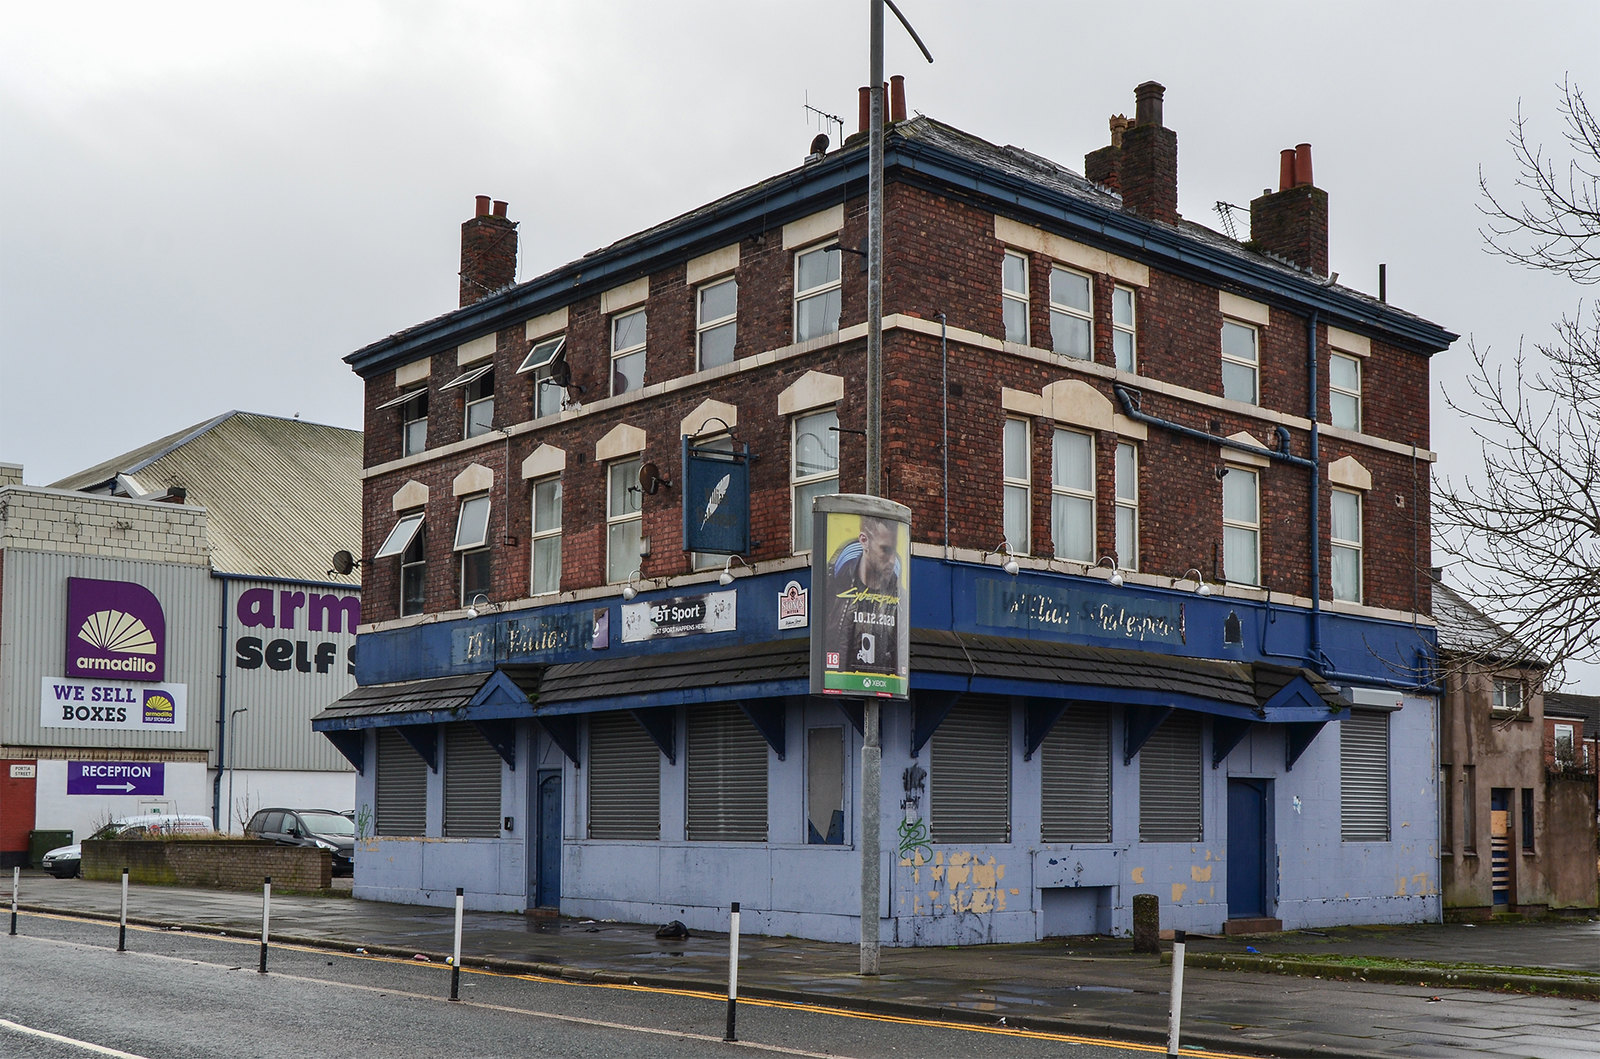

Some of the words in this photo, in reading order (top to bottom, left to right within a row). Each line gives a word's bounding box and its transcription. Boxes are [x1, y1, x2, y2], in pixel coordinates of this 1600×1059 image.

[671, 604, 700, 622] Sport
[853, 611, 895, 626] 10.12.2020
[236, 636, 336, 673] self
[827, 653, 839, 664] 18
[76, 656, 156, 673] armadillo
[53, 684, 85, 701] WE
[91, 686, 136, 703] SELL
[62, 705, 127, 722] BOXES
[82, 765, 151, 778] RECEPTION
